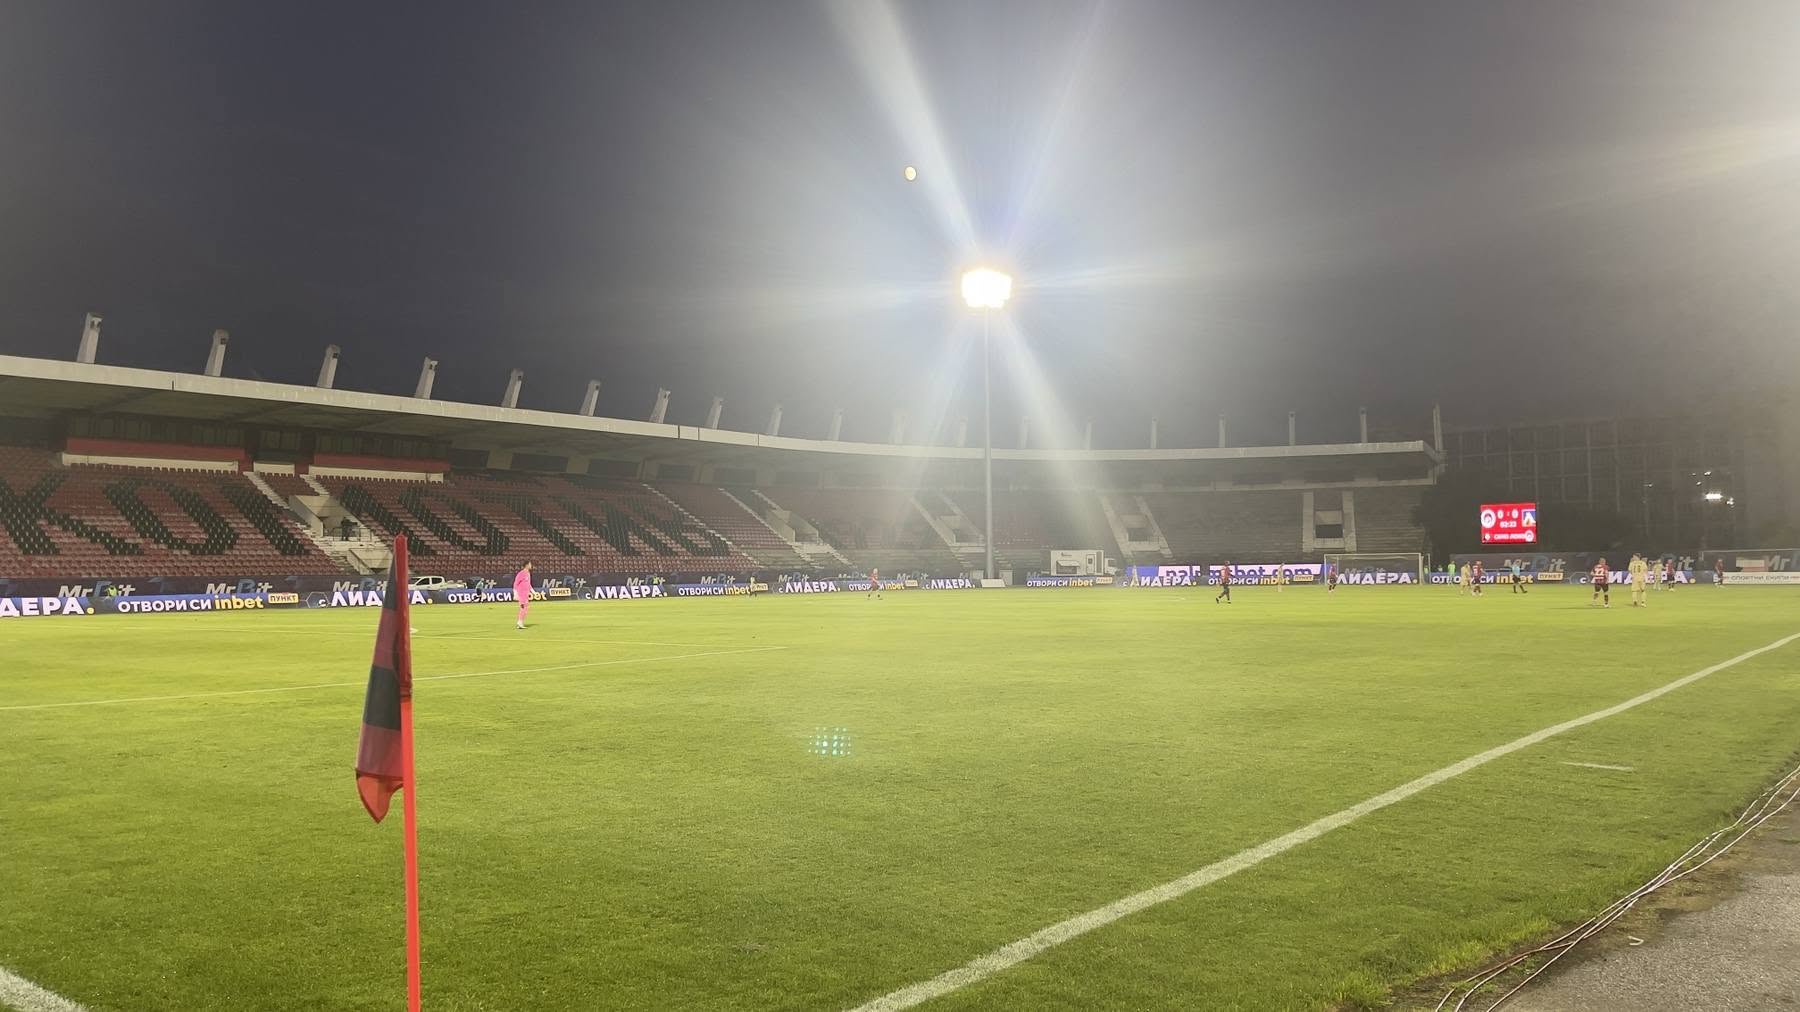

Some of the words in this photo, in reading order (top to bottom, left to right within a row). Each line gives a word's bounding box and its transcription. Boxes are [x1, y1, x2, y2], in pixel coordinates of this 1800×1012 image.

[542, 576, 587, 588] MrBit
[626, 574, 666, 586] Mrt
[1069, 578, 1094, 587] inbet
[1208, 577, 1245, 585] ОТОРИ
[1246, 576, 1259, 585] СИ
[1336, 572, 1418, 585] ЛИДЕРА.
[1480, 575, 1494, 584] СИ
[205, 578, 273, 594] MrBit
[678, 587, 712, 596] ОТВОРИ
[713, 586, 725, 595] СИ
[725, 584, 751, 595] inbet
[848, 583, 872, 591] ОТВОР
[331, 590, 433, 607] ЛИДА.
[496, 591, 512, 602] СИ
[118, 600, 187, 613] ОТВОРИ
[189, 599, 212, 611] СИ
[214, 595, 264, 609] inbet
